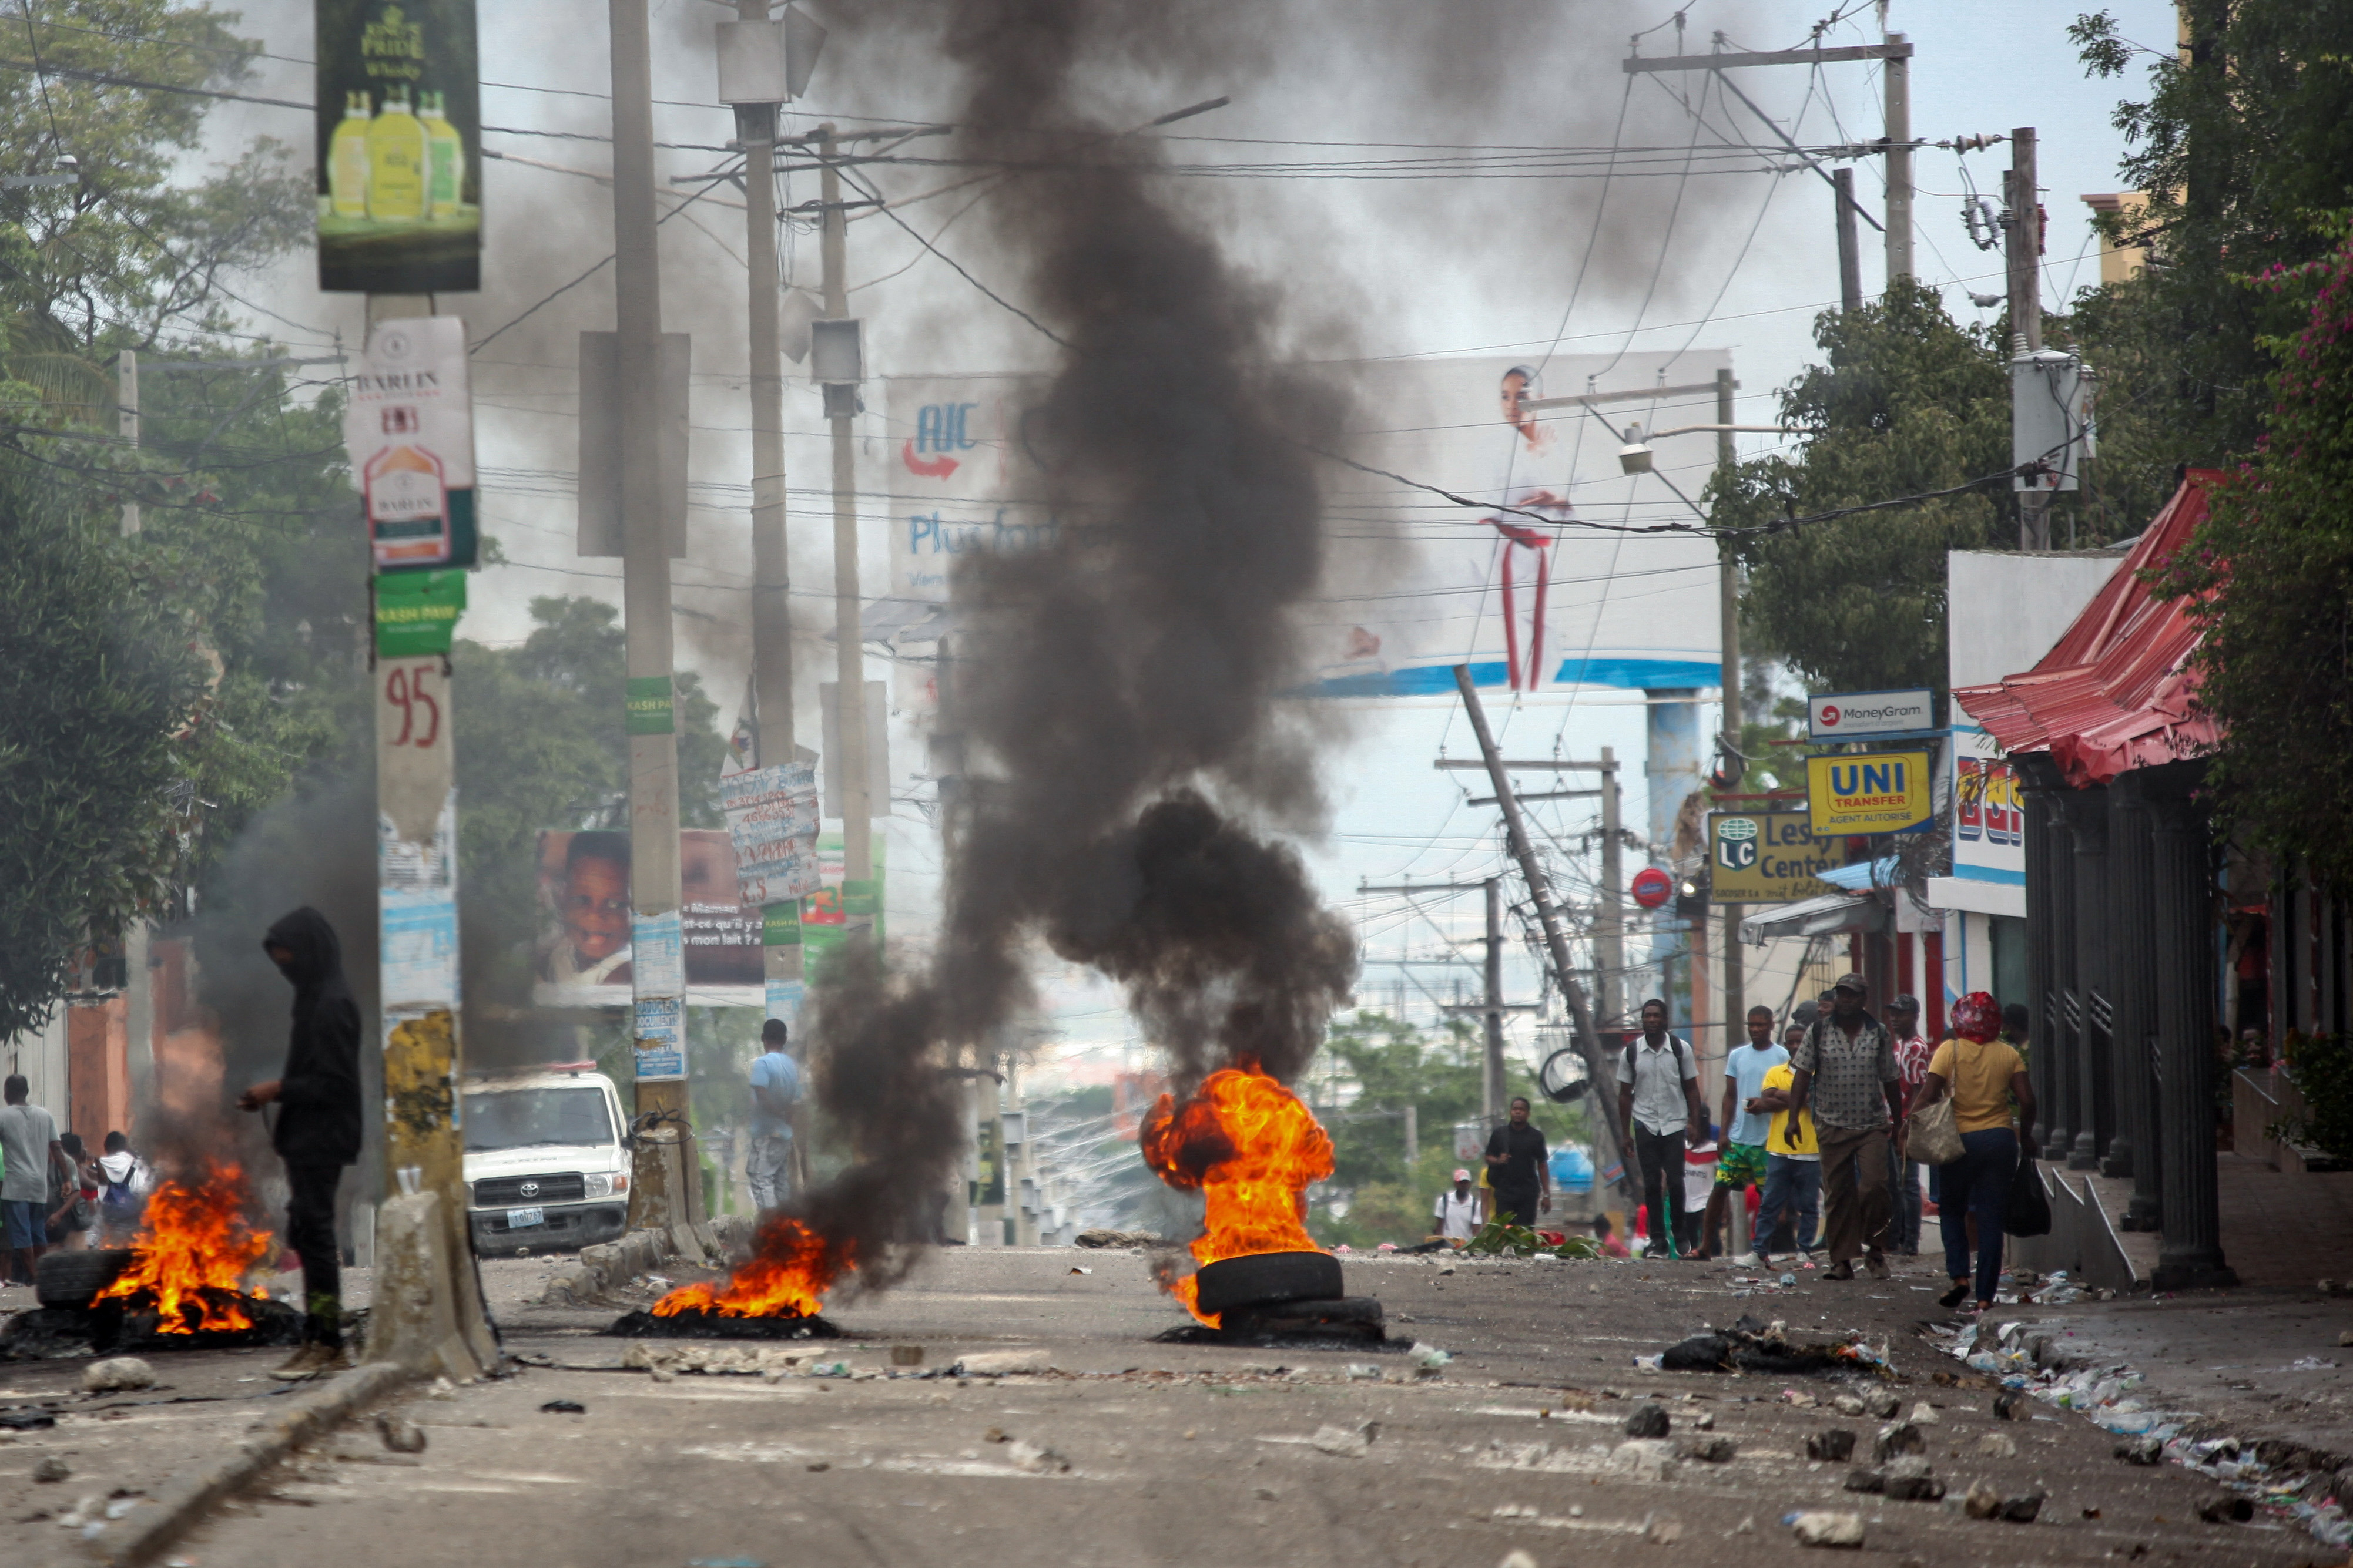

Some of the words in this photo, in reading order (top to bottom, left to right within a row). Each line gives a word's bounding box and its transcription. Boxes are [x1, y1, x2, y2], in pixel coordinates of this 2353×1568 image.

[386, 665, 440, 748] 95
[1843, 706, 1921, 720] MoneyGram
[1831, 763, 1905, 795] UNI
[1835, 795, 1906, 807] TRANSFER
[1829, 815, 1861, 824] AGENT
[1864, 812, 1912, 822] AUTORISE
[691, 936, 721, 946] mon
[635, 1000, 679, 1015] RADUCTION
